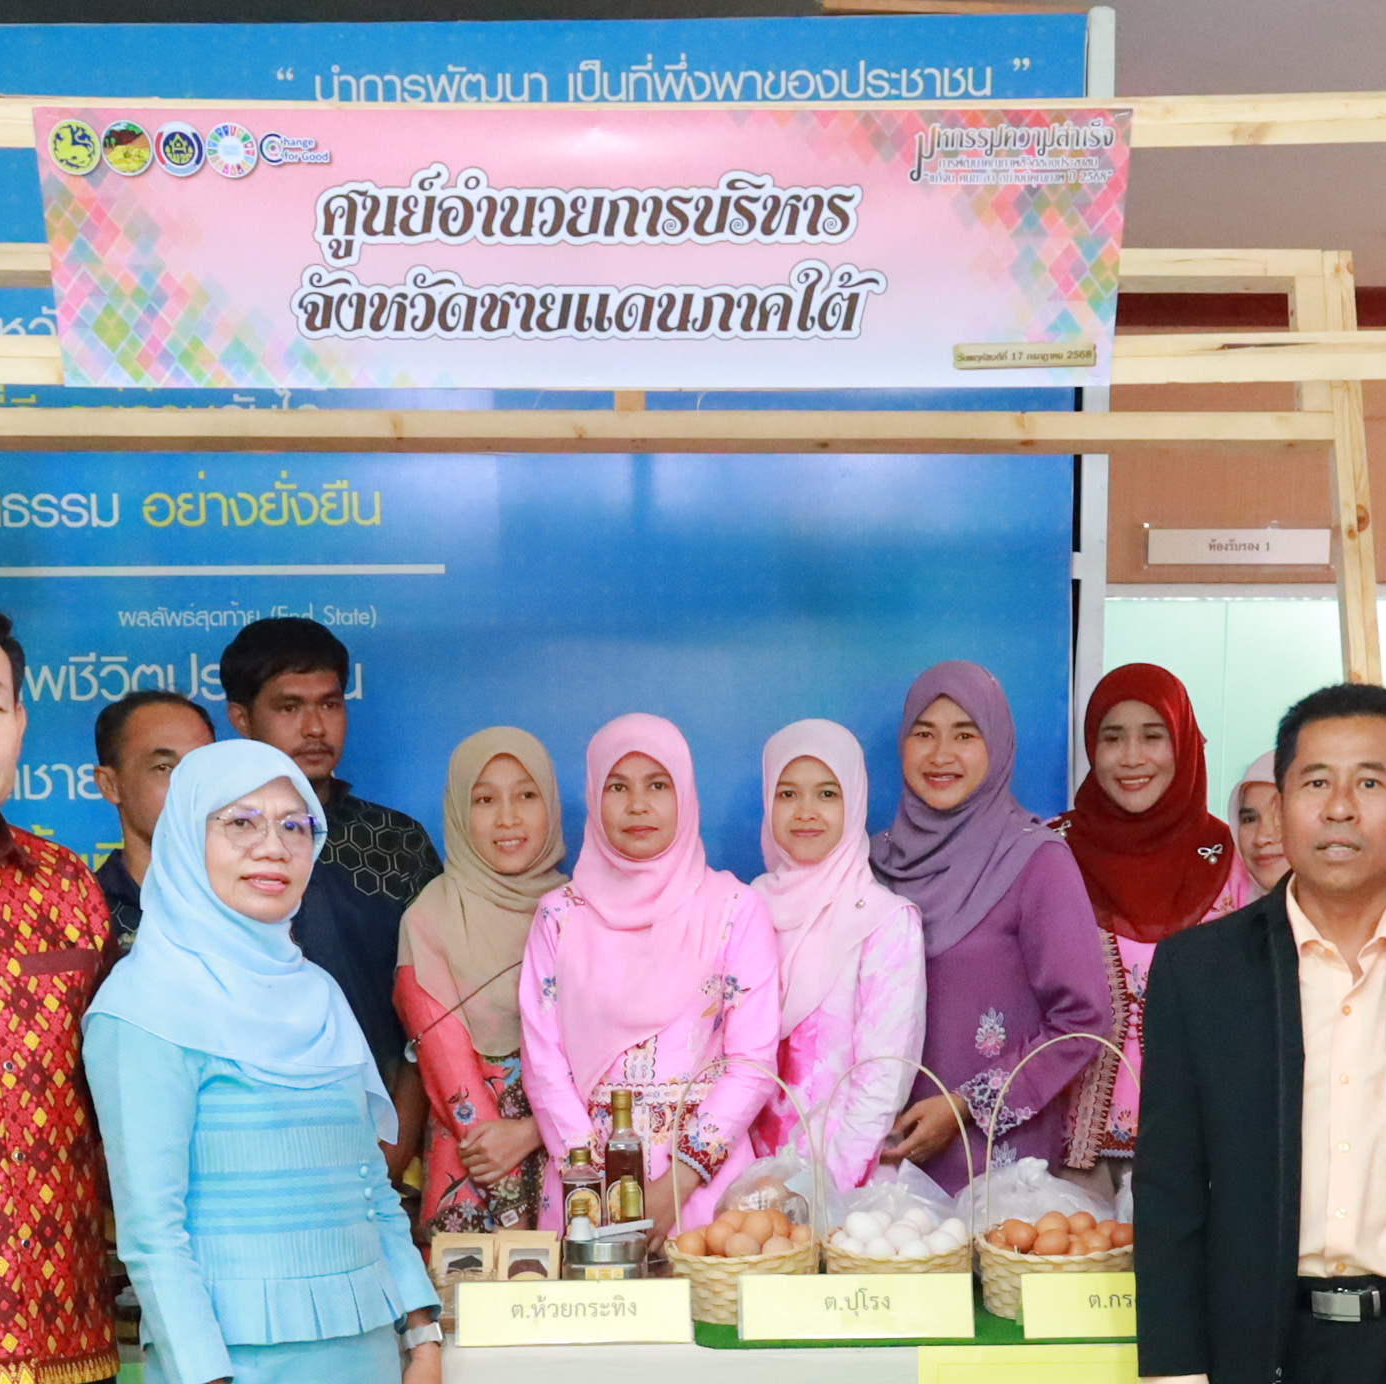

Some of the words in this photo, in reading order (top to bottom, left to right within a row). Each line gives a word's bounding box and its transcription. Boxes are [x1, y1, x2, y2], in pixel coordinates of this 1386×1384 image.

[567, 53, 993, 101] เป็นที่พึ่งพาของประชาชน
[322, 170, 853, 258] ศูนย์อำนวยการบริหาร
[298, 270, 875, 334] จังหวัดชายแดนภาคใต้
[142, 471, 381, 527] อย่างยั่งยืน
[323, 605, 378, 629] State)
[511, 1297, 638, 1320] ต.ห้วยกระทิง
[824, 1289, 892, 1315] ต.ปุโรง
[1088, 1290, 1135, 1310] ต.กร
